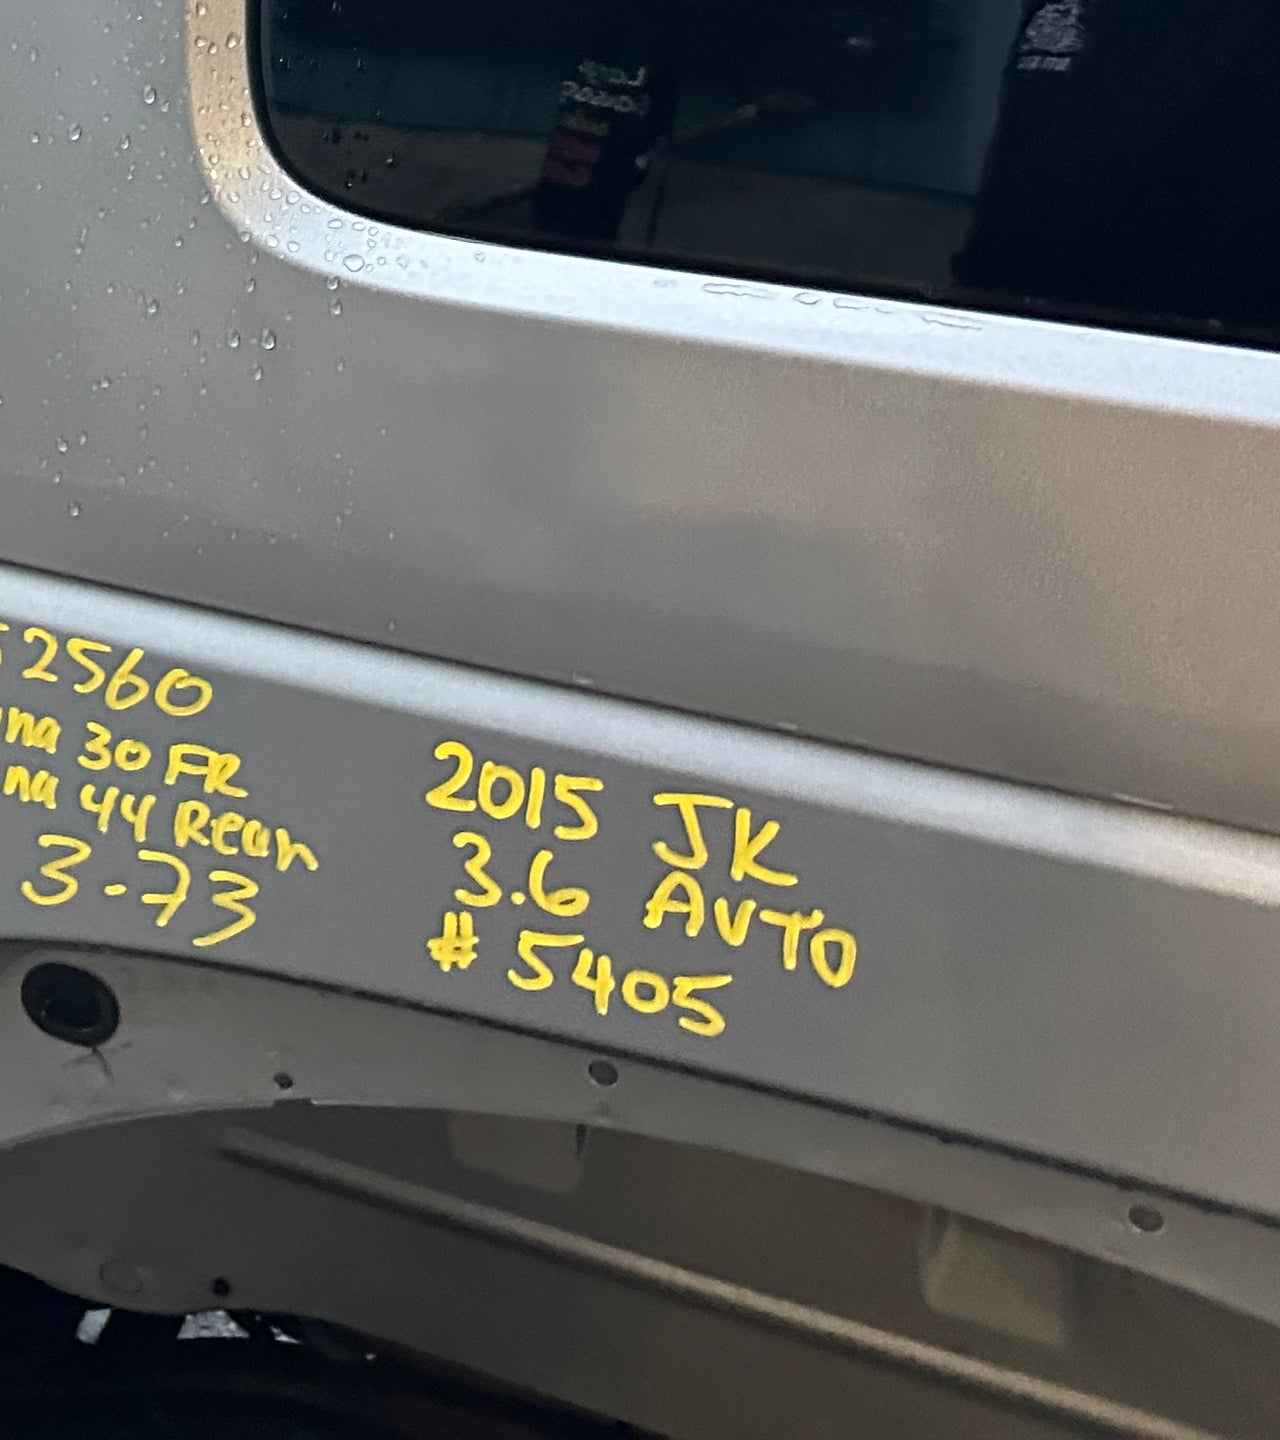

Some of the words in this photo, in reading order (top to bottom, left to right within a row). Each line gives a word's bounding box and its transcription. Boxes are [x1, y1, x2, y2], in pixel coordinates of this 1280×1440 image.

[77, 721, 152, 772] 30
[163, 743, 249, 798] FR
[79, 783, 157, 843] 44
[173, 799, 320, 872] Rear
[425, 740, 605, 841] 2015
[652, 792, 799, 887] JK
[452, 831, 591, 917] 3.6
[507, 929, 734, 1037] 5405
